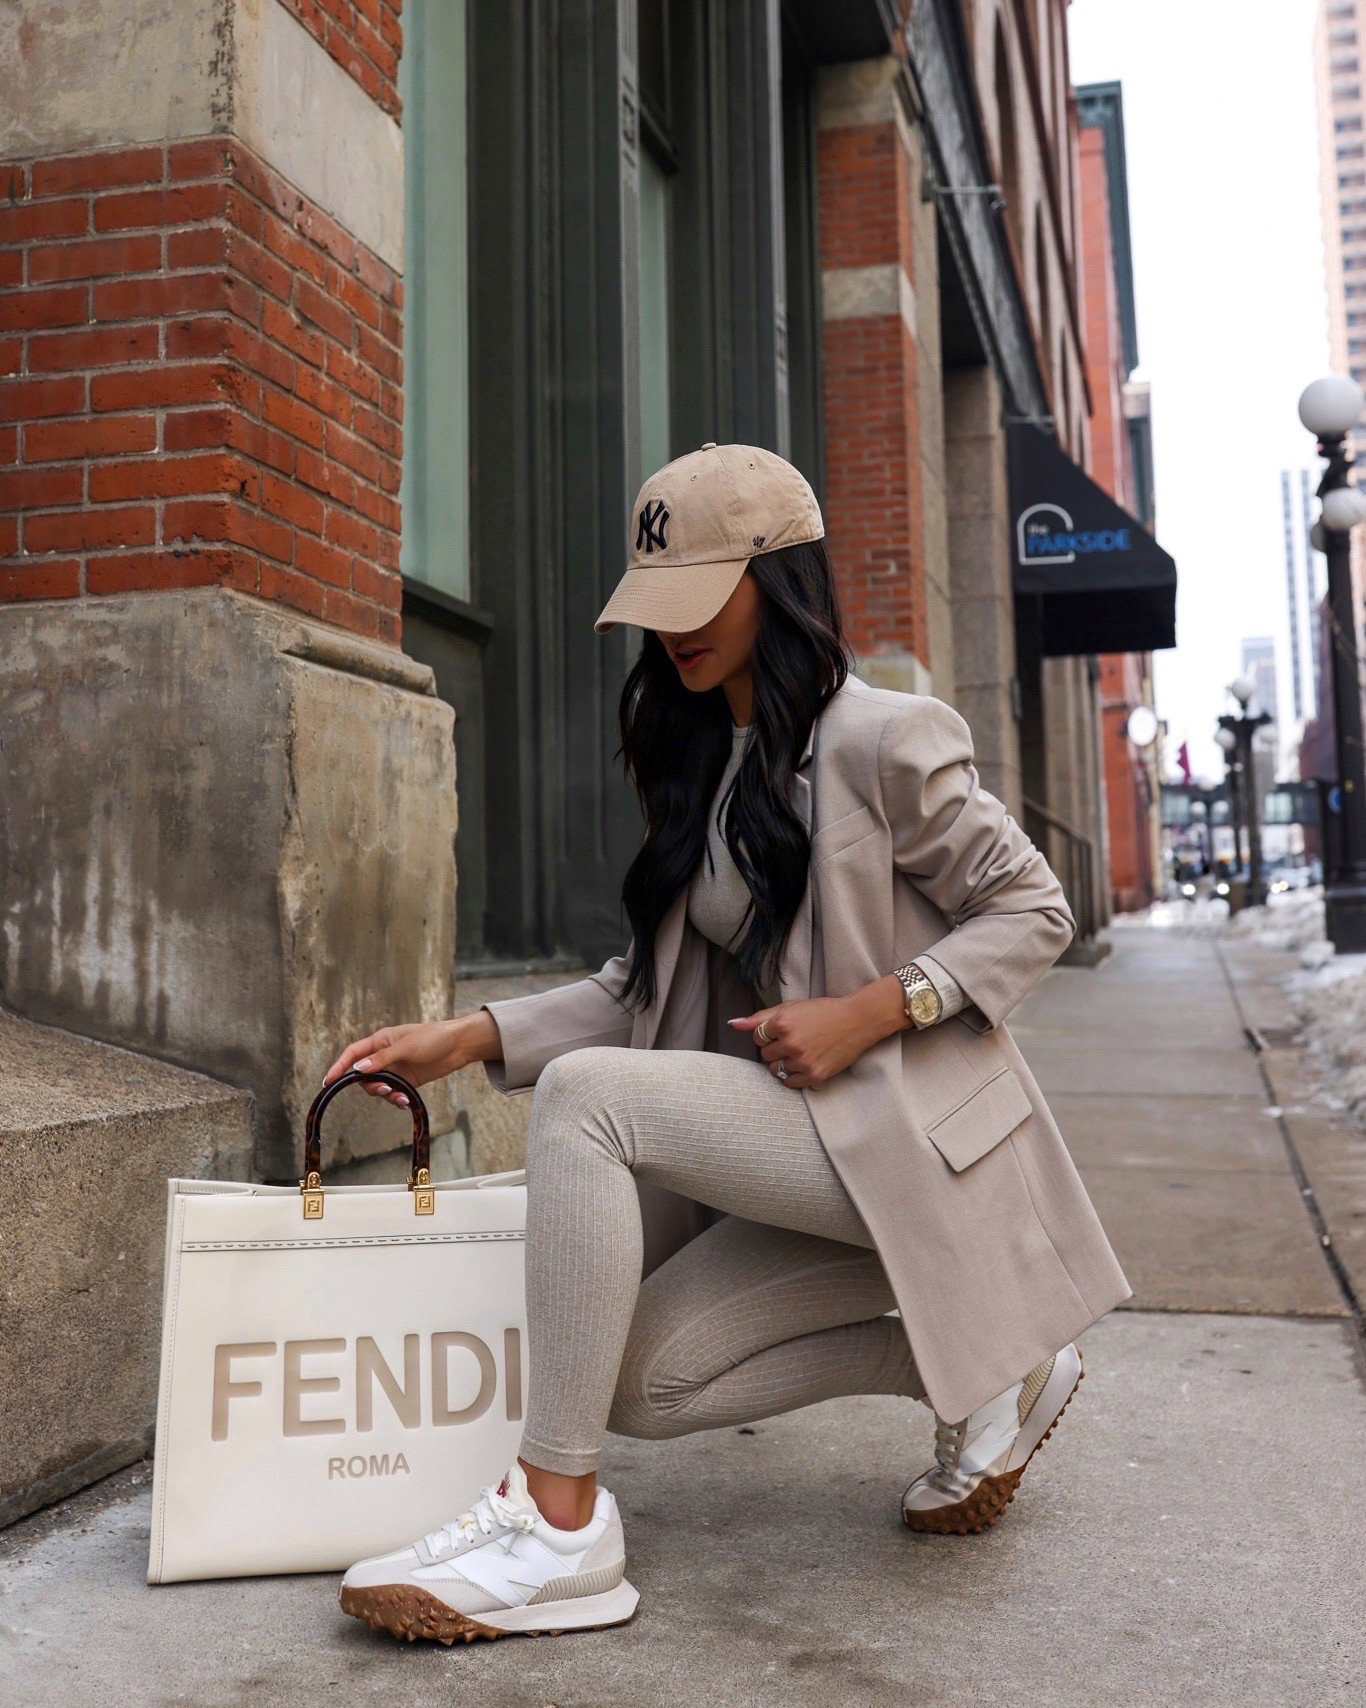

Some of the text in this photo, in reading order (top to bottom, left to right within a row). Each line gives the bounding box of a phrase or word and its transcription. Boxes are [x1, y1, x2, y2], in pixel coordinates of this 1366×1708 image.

[1028, 528, 1130, 554] PARKSIDE
[211, 1327, 523, 1442] FENDI
[327, 1452, 411, 1480] ROMA
